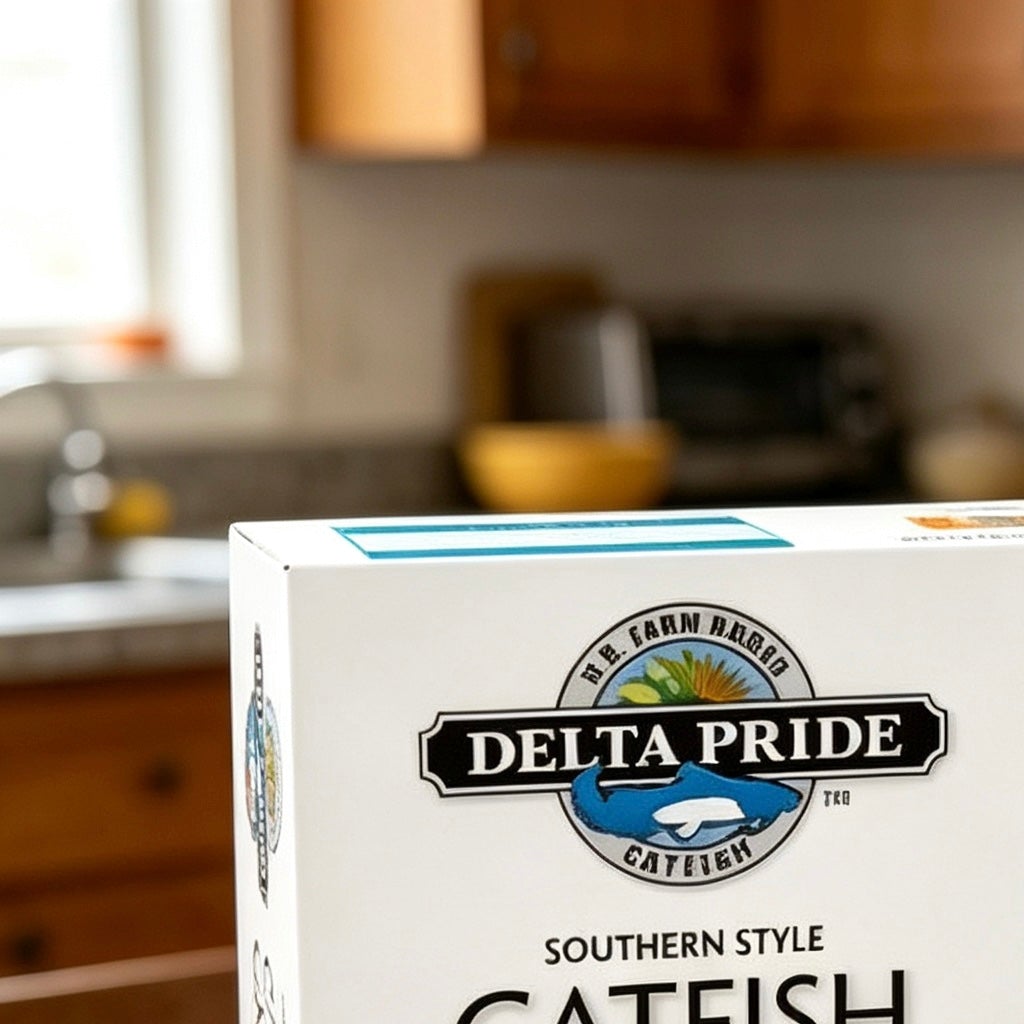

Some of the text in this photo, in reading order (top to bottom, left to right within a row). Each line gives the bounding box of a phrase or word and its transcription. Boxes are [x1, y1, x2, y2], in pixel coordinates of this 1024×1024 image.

[466, 715, 902, 776] DELTA PRIDE
[545, 925, 824, 965] SOUTHERN STYLE
